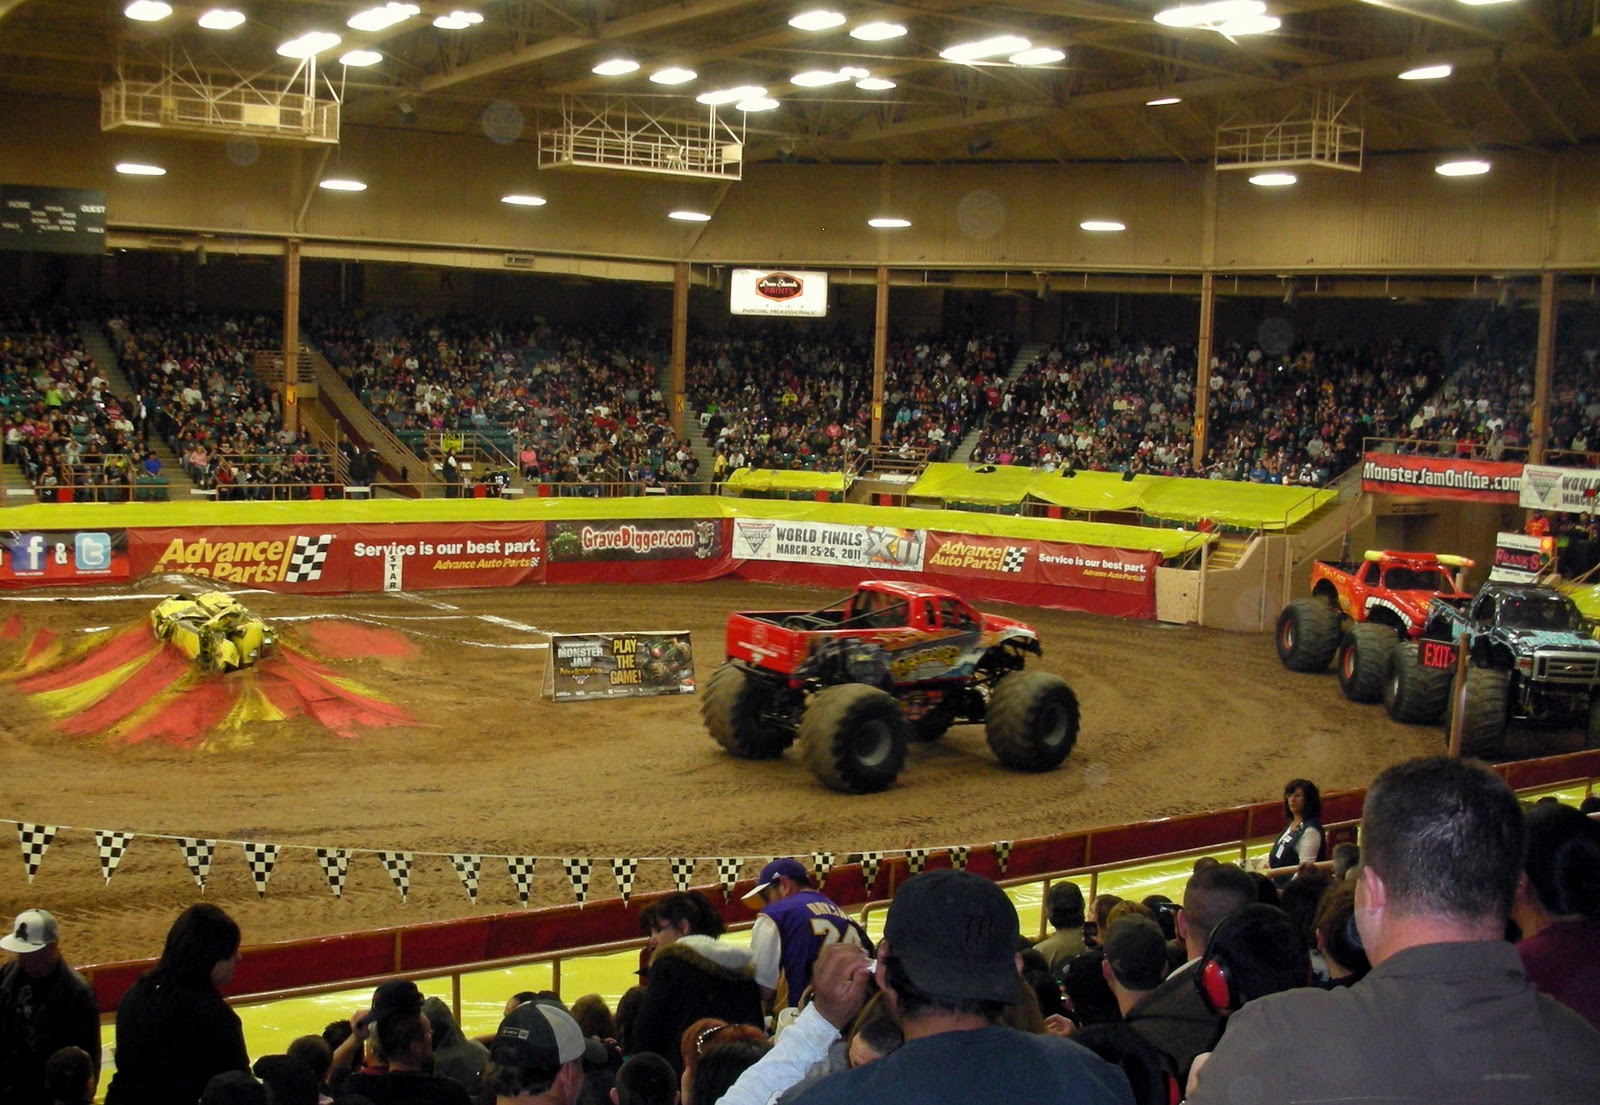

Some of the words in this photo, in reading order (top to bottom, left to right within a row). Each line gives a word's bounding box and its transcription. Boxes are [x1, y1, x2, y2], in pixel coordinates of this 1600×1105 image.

[80, 205, 106, 214] GUEST
[1362, 462, 1521, 493] MonsterJamOnline.com
[582, 525, 695, 553] GraveDigger.com
[776, 527, 817, 543] WORLD
[821, 529, 863, 547] FINALS
[55, 542, 68, 565] &
[158, 537, 285, 564] Advance
[354, 541, 416, 557] Service
[420, 541, 434, 556] is
[436, 542, 463, 556] our
[466, 540, 501, 554] best
[504, 538, 541, 556] part.
[776, 543, 807, 556] MARCH
[842, 548, 862, 560] 2011
[937, 541, 1002, 559] Advance
[433, 559, 476, 570] Advance
[477, 558, 502, 569] Auto
[502, 557, 530, 568] Parts
[929, 553, 962, 567] Auto
[962, 556, 999, 572] Parts
[1038, 553, 1074, 566] Service
[1075, 557, 1084, 566] is
[1085, 559, 1101, 569] our
[1101, 558, 1123, 571] best
[1123, 562, 1147, 574] part.
[212, 561, 279, 583] Parts
[1082, 568, 1107, 578] Advance
[1107, 571, 1123, 580] Auto
[1122, 573, 1140, 583] Parts
[557, 646, 604, 659] MONSTER
[613, 638, 638, 654] PLAY
[570, 657, 592, 668] JAM
[616, 654, 636, 669] THE
[1424, 642, 1451, 669] EXIT
[610, 669, 643, 685] GAME!
